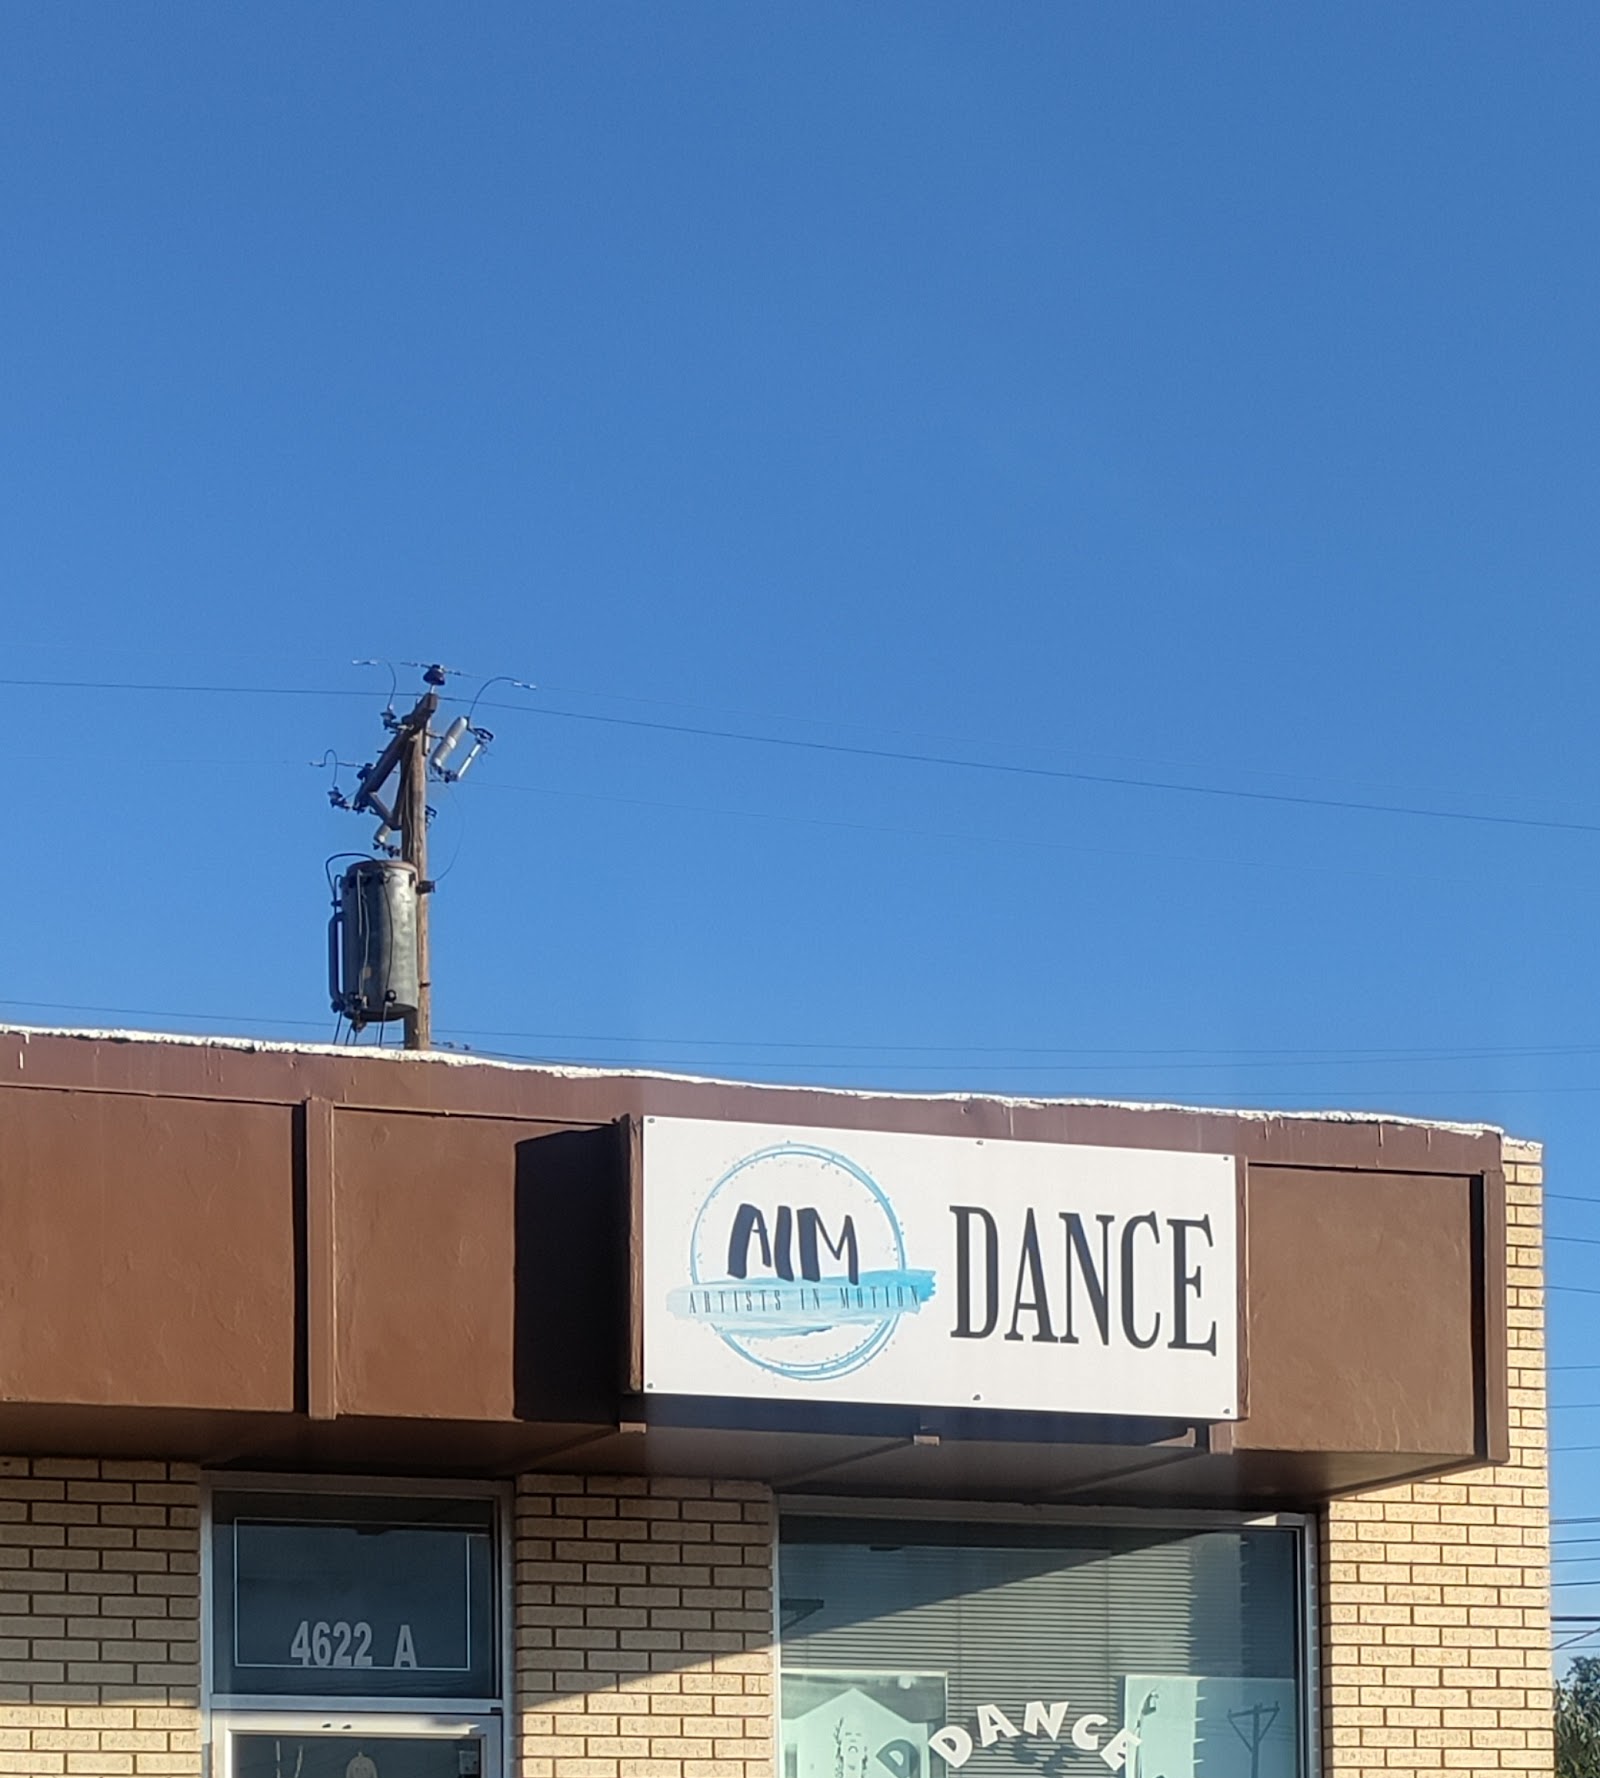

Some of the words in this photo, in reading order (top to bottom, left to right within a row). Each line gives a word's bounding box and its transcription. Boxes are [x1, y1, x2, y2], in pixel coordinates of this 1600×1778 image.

[727, 1203, 858, 1284] AIM
[689, 1289, 781, 1314] ARTISTS
[800, 1287, 821, 1311] IN
[840, 1284, 919, 1310] MOTION
[950, 1205, 1217, 1356] DANCE
[290, 1620, 372, 1667] 4622
[393, 1624, 417, 1668] A
[928, 1700, 1142, 1771] DANCE
